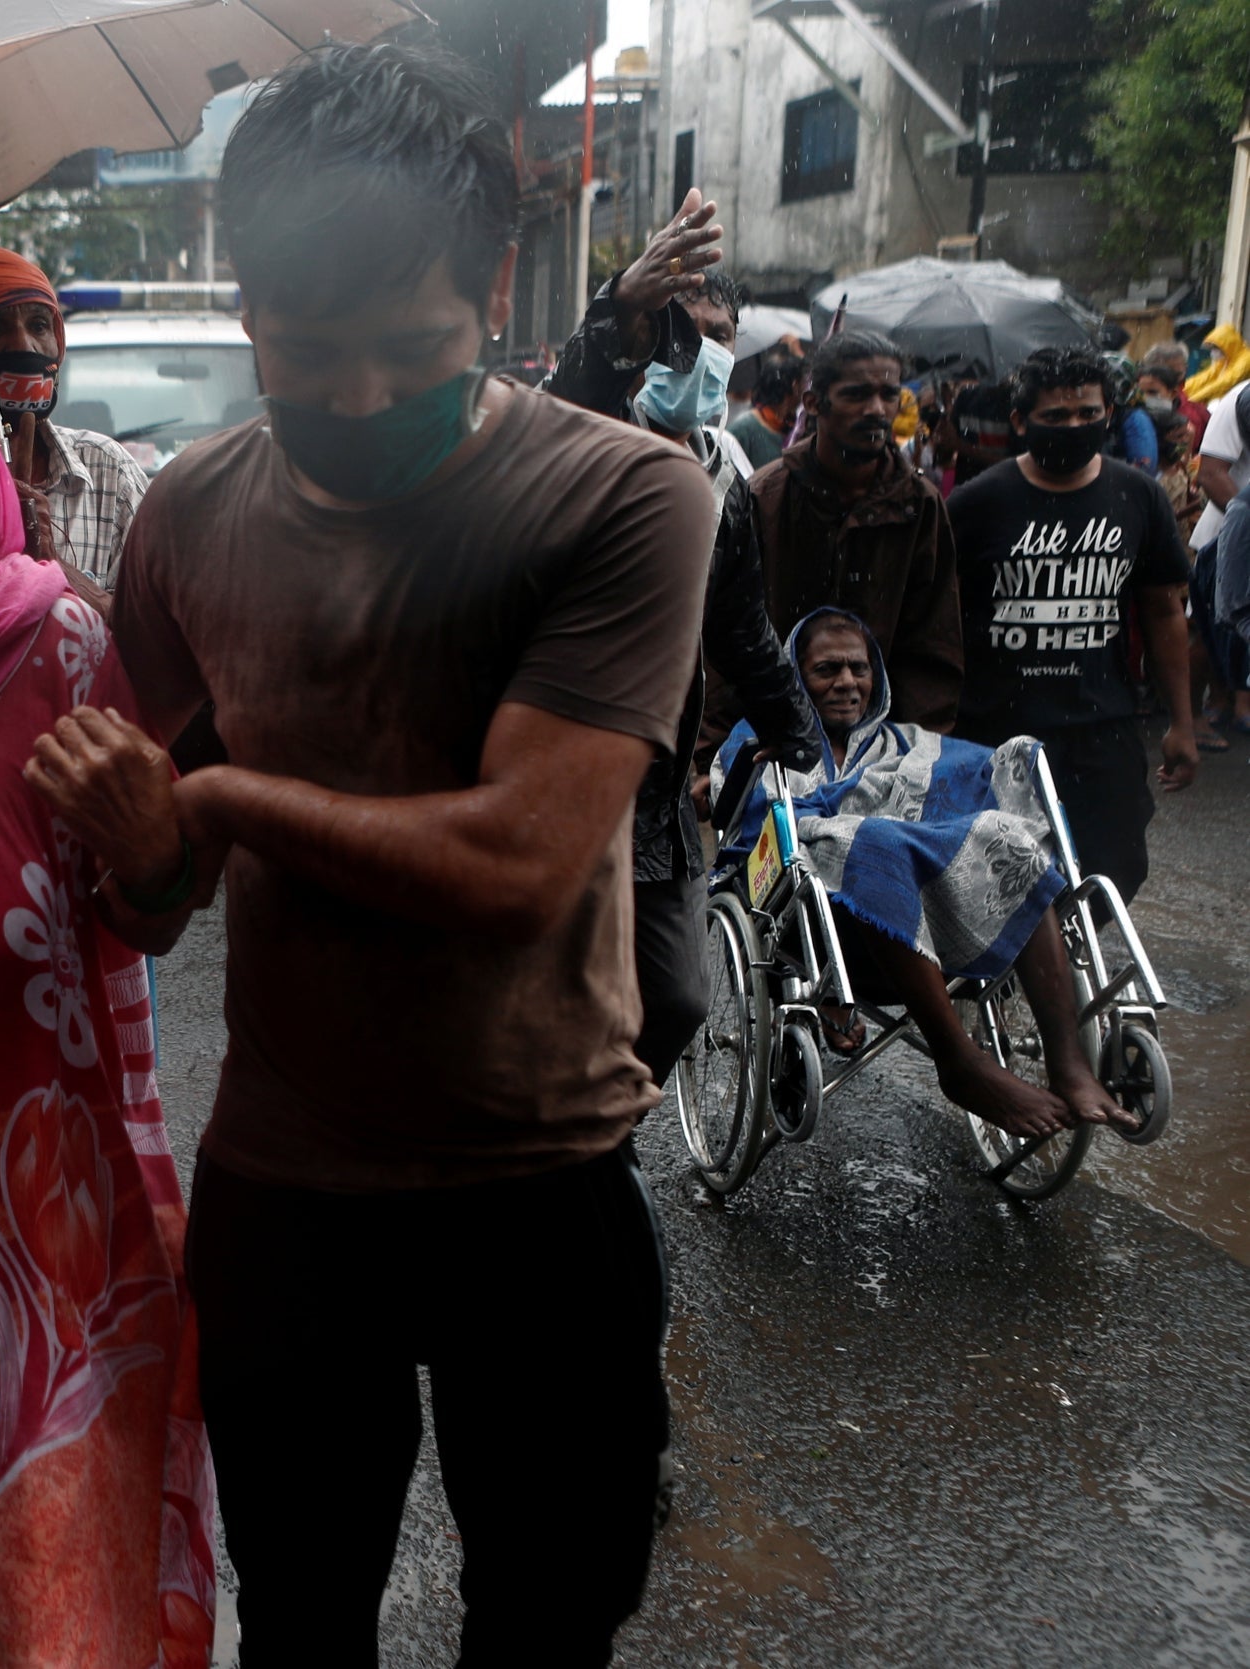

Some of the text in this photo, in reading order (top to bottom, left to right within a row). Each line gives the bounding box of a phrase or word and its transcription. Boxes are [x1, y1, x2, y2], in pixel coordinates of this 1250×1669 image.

[1010, 516, 1122, 557] Ask Me
[992, 556, 1134, 598] ANYTHING
[1000, 604, 1117, 619] I'M HERE
[989, 623, 1120, 650] TO HELP
